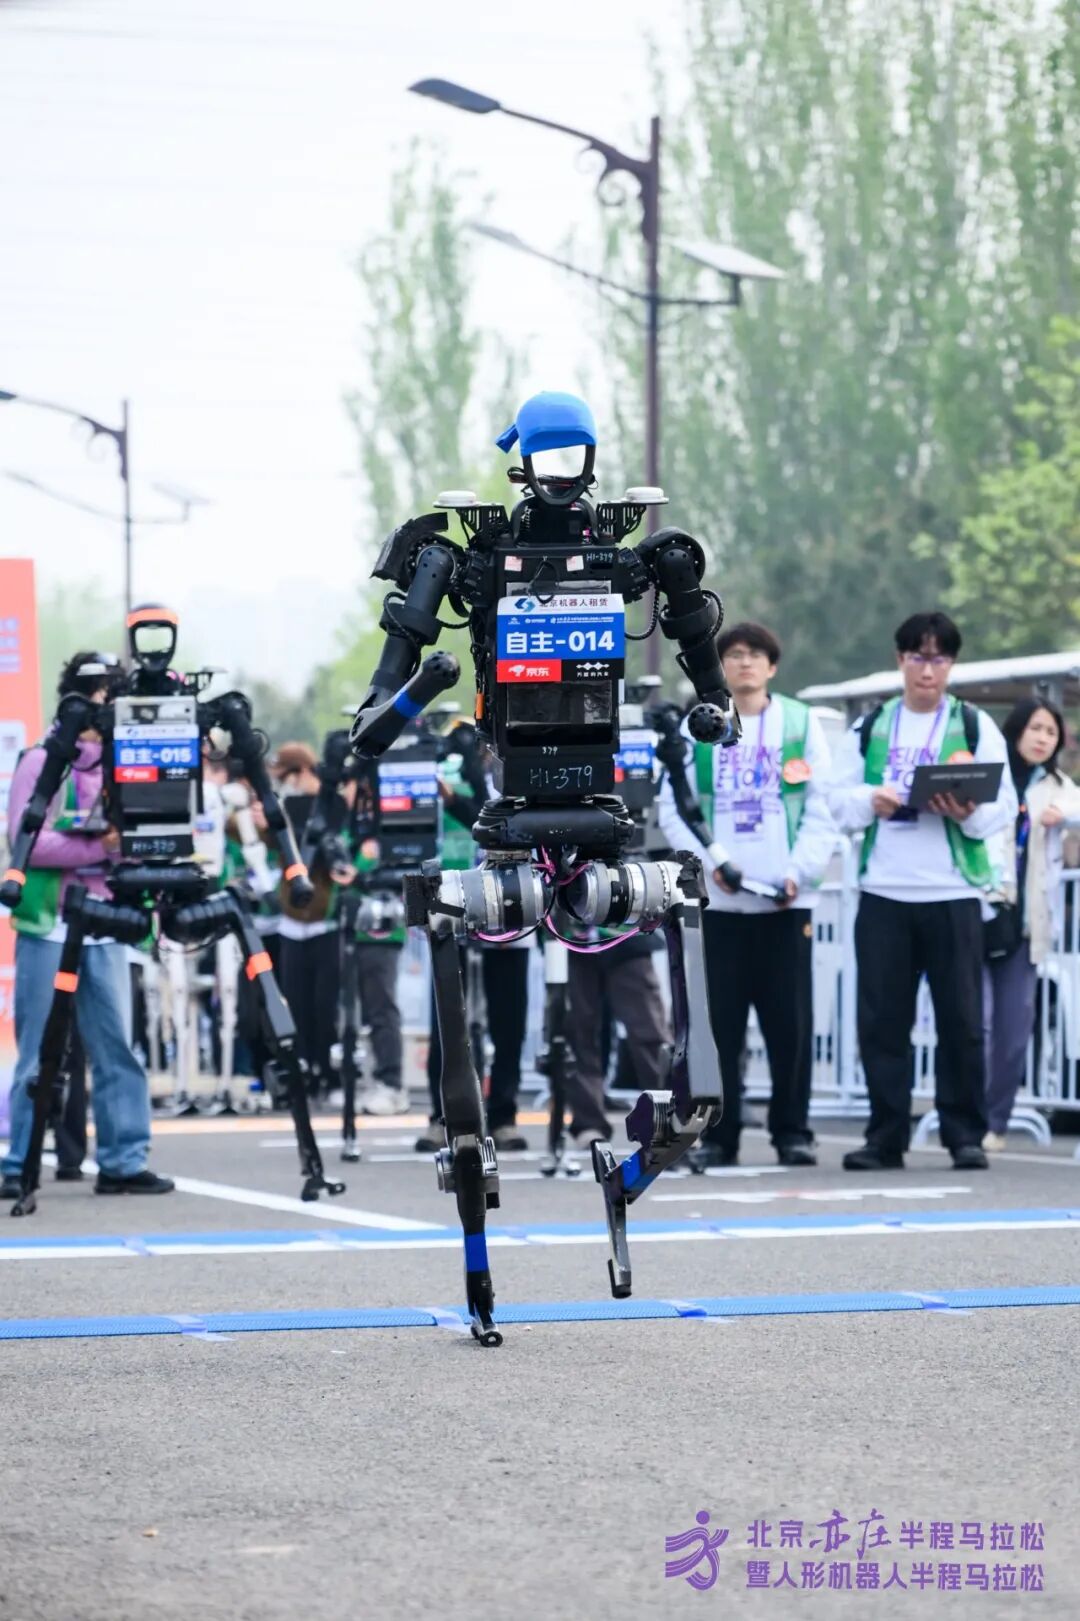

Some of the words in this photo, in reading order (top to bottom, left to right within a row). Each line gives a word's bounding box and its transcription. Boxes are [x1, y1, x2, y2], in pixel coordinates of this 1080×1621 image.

[506, 631, 615, 654] 自主-014
[526, 667, 550, 677] 京东
[120, 747, 192, 765] 自主-015
